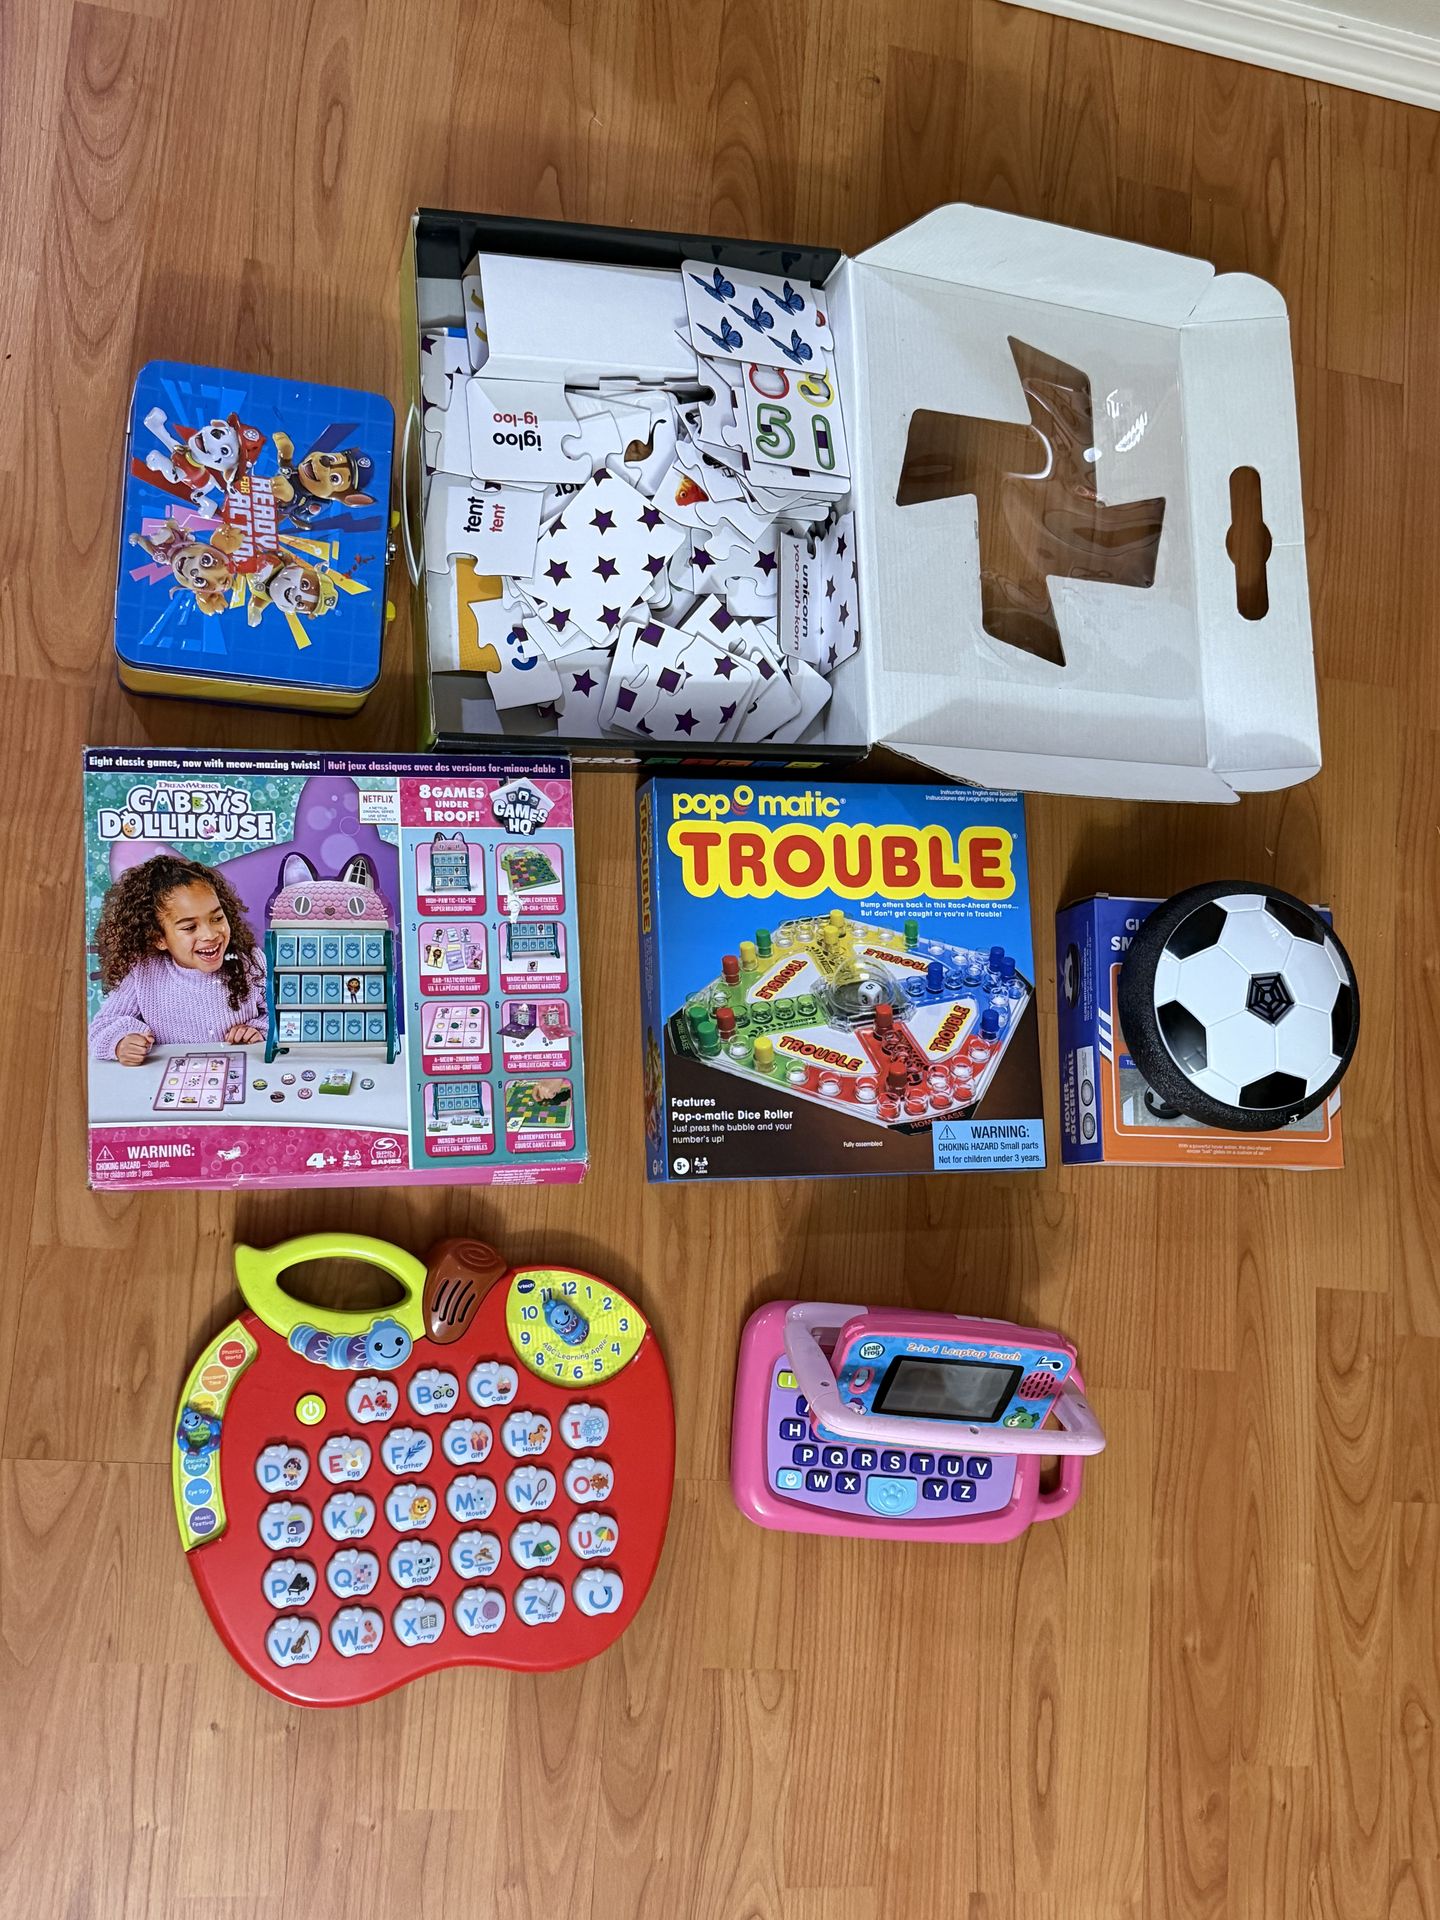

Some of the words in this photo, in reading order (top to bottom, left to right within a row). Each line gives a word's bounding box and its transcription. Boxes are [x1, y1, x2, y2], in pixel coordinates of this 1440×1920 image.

[493, 411, 538, 428] ig-loo
[756, 403, 796, 459] 5
[493, 430, 542, 451] igloo
[240, 476, 250, 494] FOR
[251, 476, 278, 550] READY
[463, 496, 484, 533] tent
[489, 504, 506, 532] tent
[793, 544, 801, 651] yoo-nuh-korn
[802, 564, 810, 638] unicorn
[89, 756, 113, 768] Eight
[115, 757, 145, 767] classic
[147, 759, 181, 769] games,
[183, 759, 202, 768] now
[204, 758, 224, 768] with
[226, 759, 289, 771] meow-mazing
[291, 759, 321, 769] twists!
[328, 761, 346, 770] Huit
[348, 761, 367, 772] jeux
[368, 762, 412, 773] classiques
[414, 764, 433, 772] avec
[435, 762, 450, 772] des
[451, 763, 486, 773] versions
[488, 764, 556, 774] for-miaou-dable
[129, 788, 249, 813] GABBY'S
[363, 795, 393, 804] NETFLIX
[435, 800, 469, 808] UNDER
[672, 793, 730, 820] pop
[493, 799, 549, 824] GAMES
[100, 810, 274, 839] DOLLHOUSE
[508, 819, 533, 835] HQ
[678, 831, 1006, 889] TROUBLE
[755, 958, 808, 1000] TROUBLE
[930, 1004, 970, 1052] TROUBLE
[779, 1035, 863, 1072] TROUBLE
[671, 1098, 716, 1107] Features
[672, 1111, 734, 1123] Pop-o-matic
[737, 1111, 761, 1120] Dice
[764, 1110, 793, 1120] Roller
[672, 1123, 688, 1133] Just
[689, 1125, 711, 1134] press
[712, 1123, 725, 1132] the
[727, 1123, 755, 1132] bubble
[757, 1122, 773, 1131] and
[775, 1123, 792, 1132] your
[971, 1125, 1030, 1139] WARNING:
[672, 1135, 710, 1144] number's
[711, 1135, 725, 1144] up!
[938, 1143, 969, 1151] CHOKING
[970, 1142, 999, 1151] HAZARD
[1000, 1141, 1020, 1150] Small
[1021, 1142, 1039, 1151] parts
[127, 1143, 195, 1159] WARNING:
[939, 1156, 951, 1164] Not
[952, 1155, 962, 1163] for
[963, 1155, 992, 1163] children
[993, 1154, 1013, 1163] under
[1014, 1154, 1020, 1162] 3
[1021, 1155, 1042, 1163] years.
[96, 1162, 119, 1171] CHOKING
[120, 1161, 141, 1170] HAZARD
[306, 1152, 337, 1168] 4+
[676, 1161, 686, 1171] 5+
[541, 1288, 552, 1301] 11
[562, 1281, 577, 1295] 12
[586, 1286, 592, 1299] 1
[603, 1297, 612, 1310] 2
[521, 1306, 538, 1320] 10
[619, 1318, 628, 1331] 3
[520, 1332, 530, 1344] 9
[543, 1342, 556, 1355] ABC
[557, 1350, 590, 1360] Learning
[591, 1338, 608, 1355] Apple
[611, 1342, 620, 1355] 4
[907, 1343, 939, 1353] 2-in-1
[989, 1350, 1022, 1361] Touch
[535, 1352, 544, 1365] 8
[594, 1359, 603, 1371] 5
[555, 1363, 563, 1376] 7
[573, 1366, 583, 1379] 6
[416, 1386, 432, 1404] B
[476, 1379, 493, 1398] C
[357, 1394, 375, 1413] A
[511, 1429, 528, 1446] H
[570, 1422, 581, 1439] I
[789, 1424, 801, 1437] H
[451, 1437, 467, 1455] G
[390, 1446, 404, 1464] F
[803, 1449, 813, 1462] P
[830, 1452, 844, 1465] Q
[862, 1454, 872, 1466] R
[890, 1456, 900, 1469] S
[328, 1455, 344, 1473] E
[396, 1462, 423, 1471] Feather
[919, 1459, 930, 1471] T
[947, 1461, 959, 1475] U
[976, 1463, 988, 1476] V
[264, 1465, 280, 1483] D
[347, 1470, 360, 1478] Egg
[813, 1475, 829, 1488] W
[573, 1476, 590, 1494] O
[844, 1477, 856, 1491] X
[933, 1485, 944, 1497] Y
[961, 1486, 971, 1498] Z
[516, 1484, 532, 1502] N
[456, 1494, 475, 1512] M
[331, 1510, 347, 1529] K
[394, 1504, 409, 1522] L
[466, 1509, 487, 1517] Mouse
[267, 1522, 284, 1541] J
[578, 1530, 592, 1549] U
[520, 1540, 533, 1559] T
[583, 1547, 611, 1555] Umbrella
[459, 1550, 475, 1570] S
[398, 1560, 413, 1578] R
[334, 1569, 353, 1588] Q
[412, 1576, 432, 1584] Robot
[272, 1579, 287, 1598] P
[525, 1596, 538, 1615] Z
[464, 1608, 478, 1626] Y
[403, 1618, 418, 1637] X
[338, 1626, 359, 1647] W
[274, 1637, 292, 1657] V
